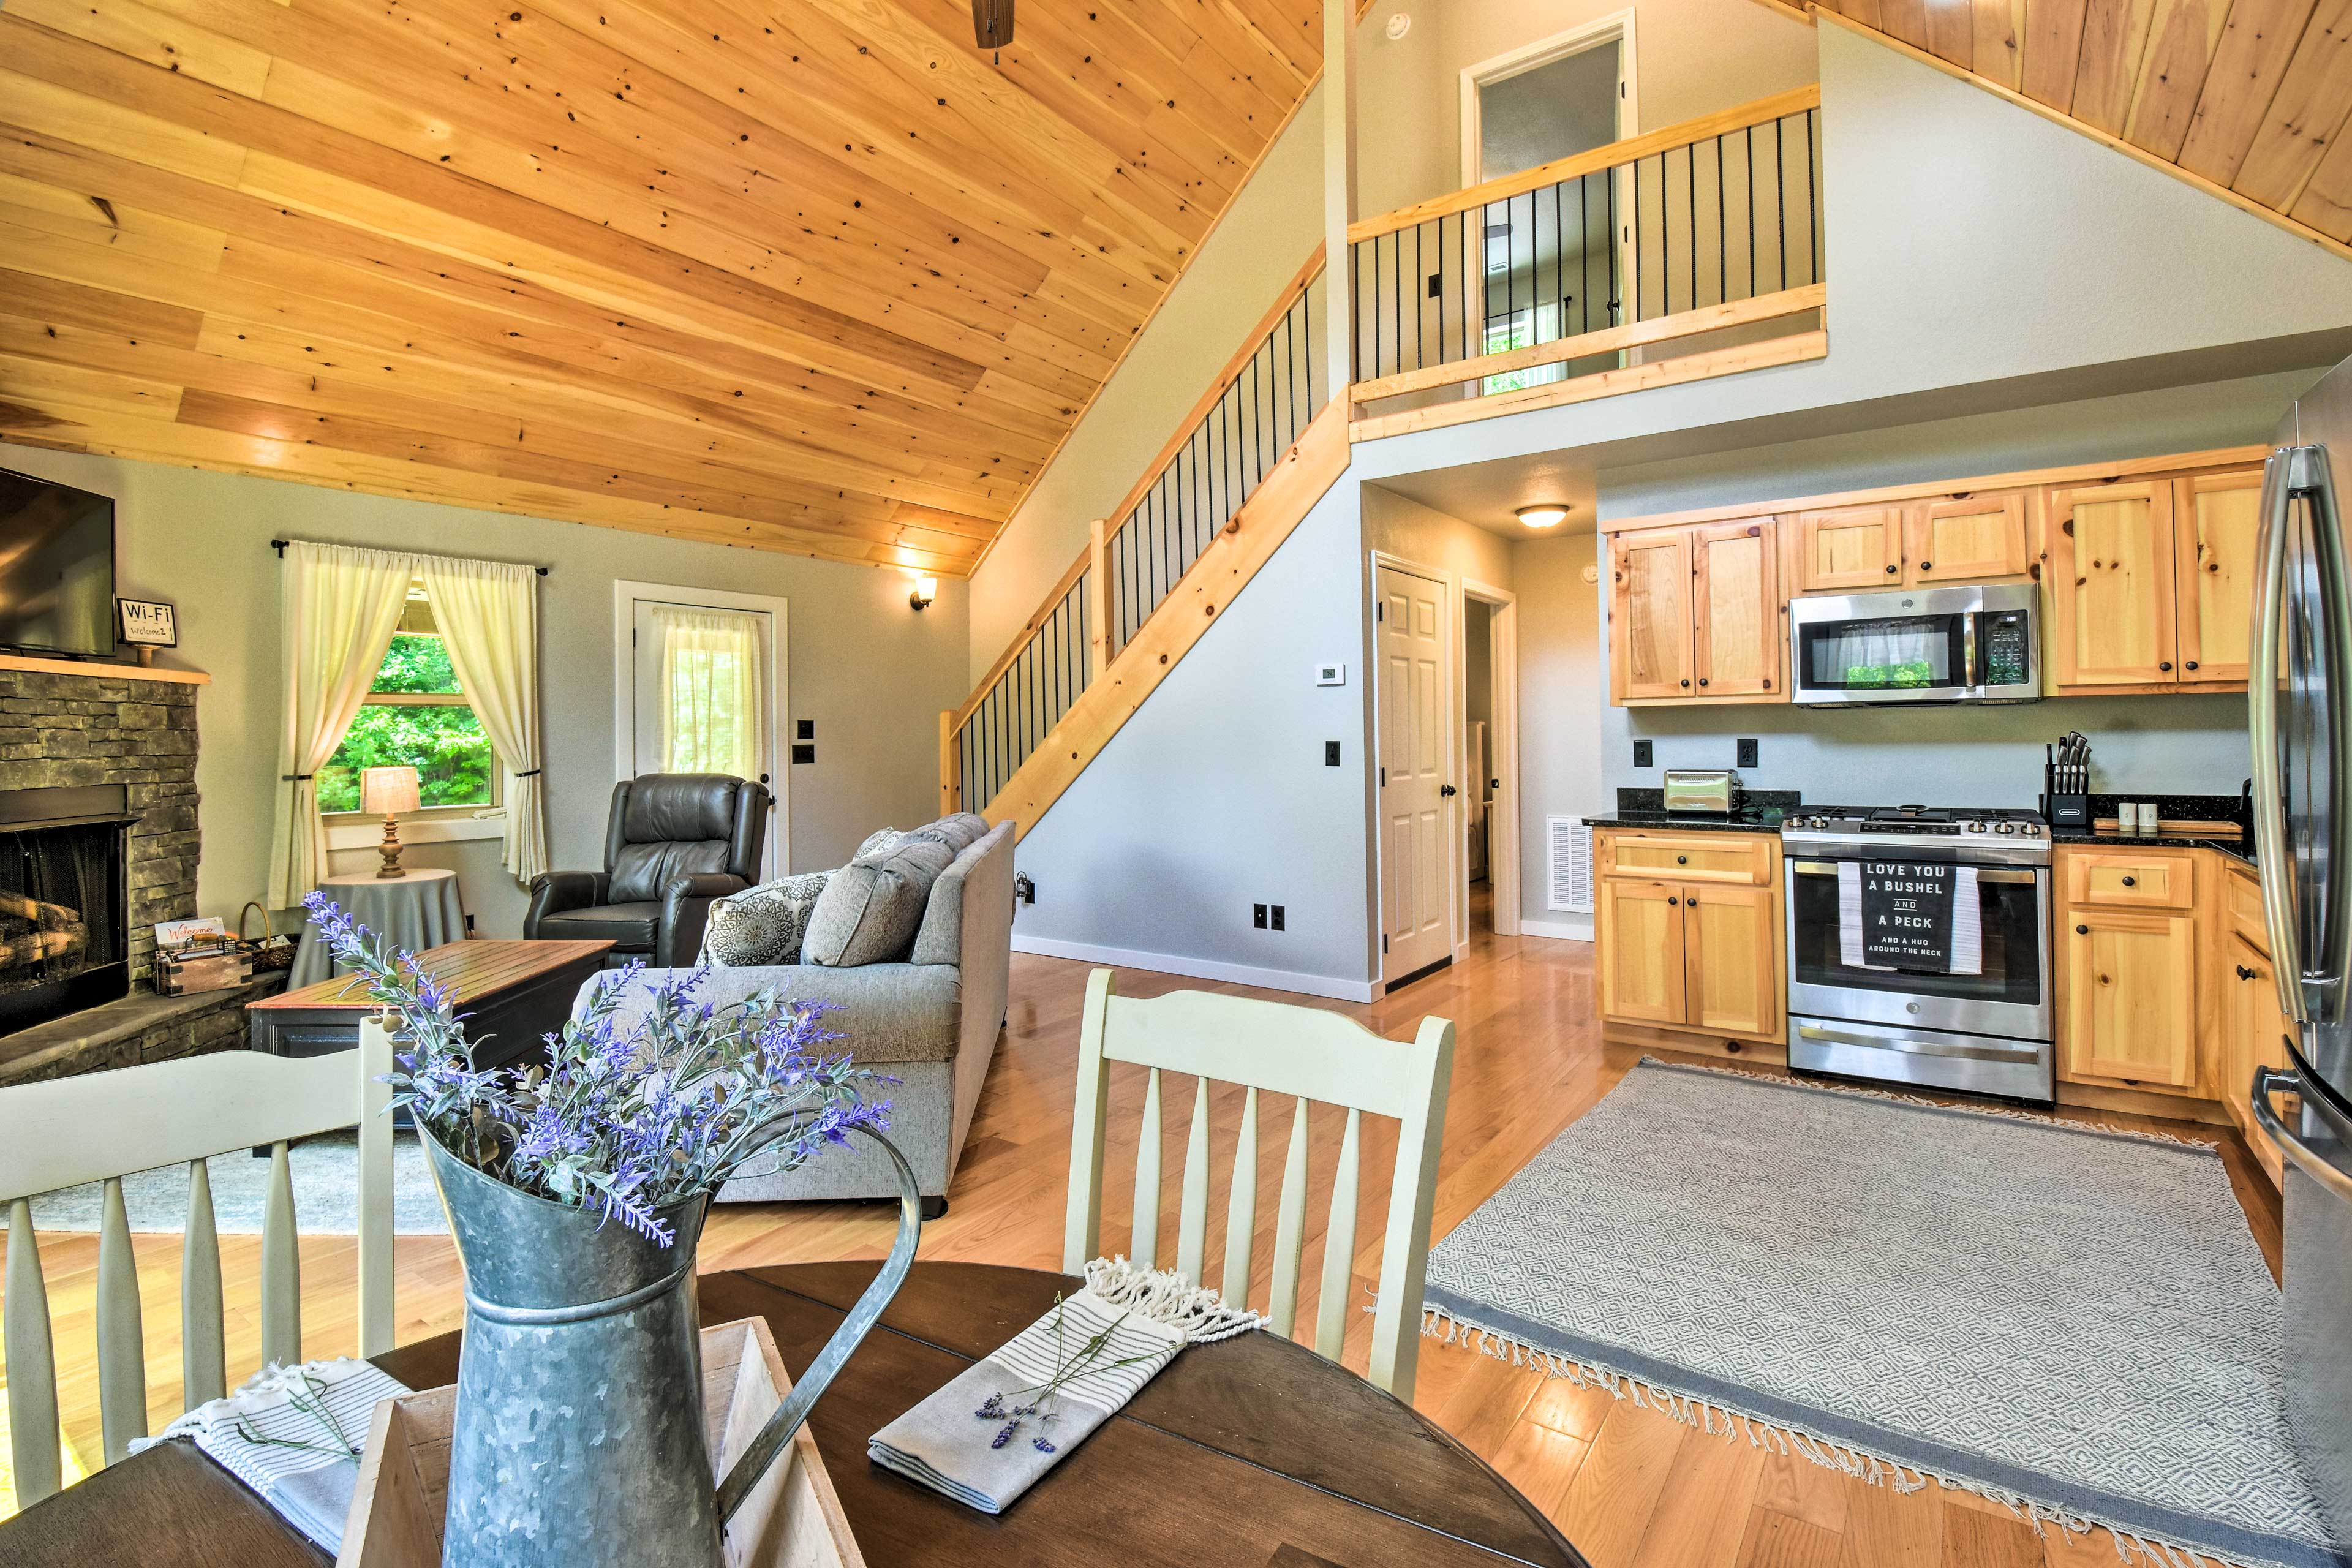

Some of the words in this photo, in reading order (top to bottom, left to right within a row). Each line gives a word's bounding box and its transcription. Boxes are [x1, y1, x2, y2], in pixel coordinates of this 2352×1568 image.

[126, 603, 170, 623] Wi-Fi
[1867, 864, 1905, 875] LOVE
[1915, 865, 1945, 877] YOU
[1869, 880, 1877, 890] A
[1885, 881, 1942, 894] BUSHEL
[1878, 915, 1887, 925] A
[1894, 916, 1932, 928] PECK
[167, 923, 213, 940] Welcome
